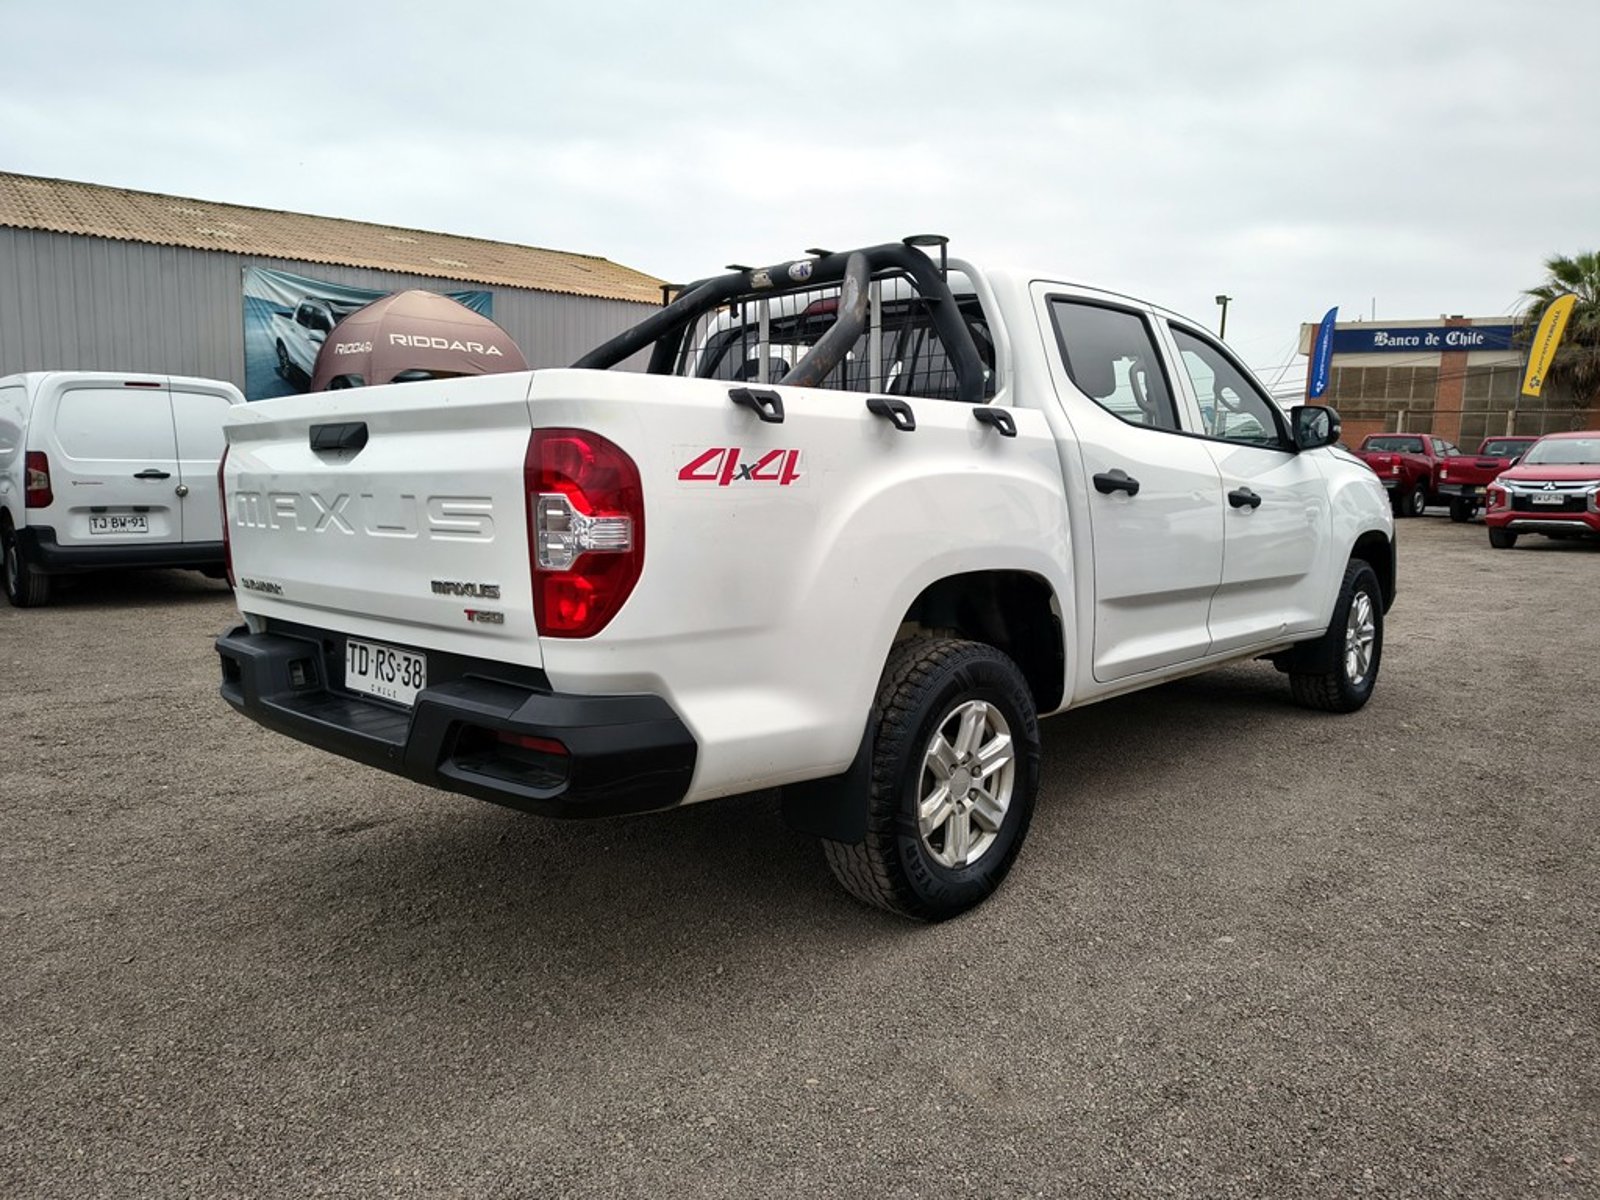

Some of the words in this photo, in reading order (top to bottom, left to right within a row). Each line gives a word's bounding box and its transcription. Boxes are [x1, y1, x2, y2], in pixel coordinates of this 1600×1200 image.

[389, 333, 504, 357] RIDDARA
[1374, 331, 1419, 346] Banco
[1425, 332, 1440, 346] de
[1446, 331, 1484, 346] Chile
[678, 448, 801, 486] 4x4
[235, 491, 495, 544] MAXUS
[430, 580, 501, 600] MAXUS
